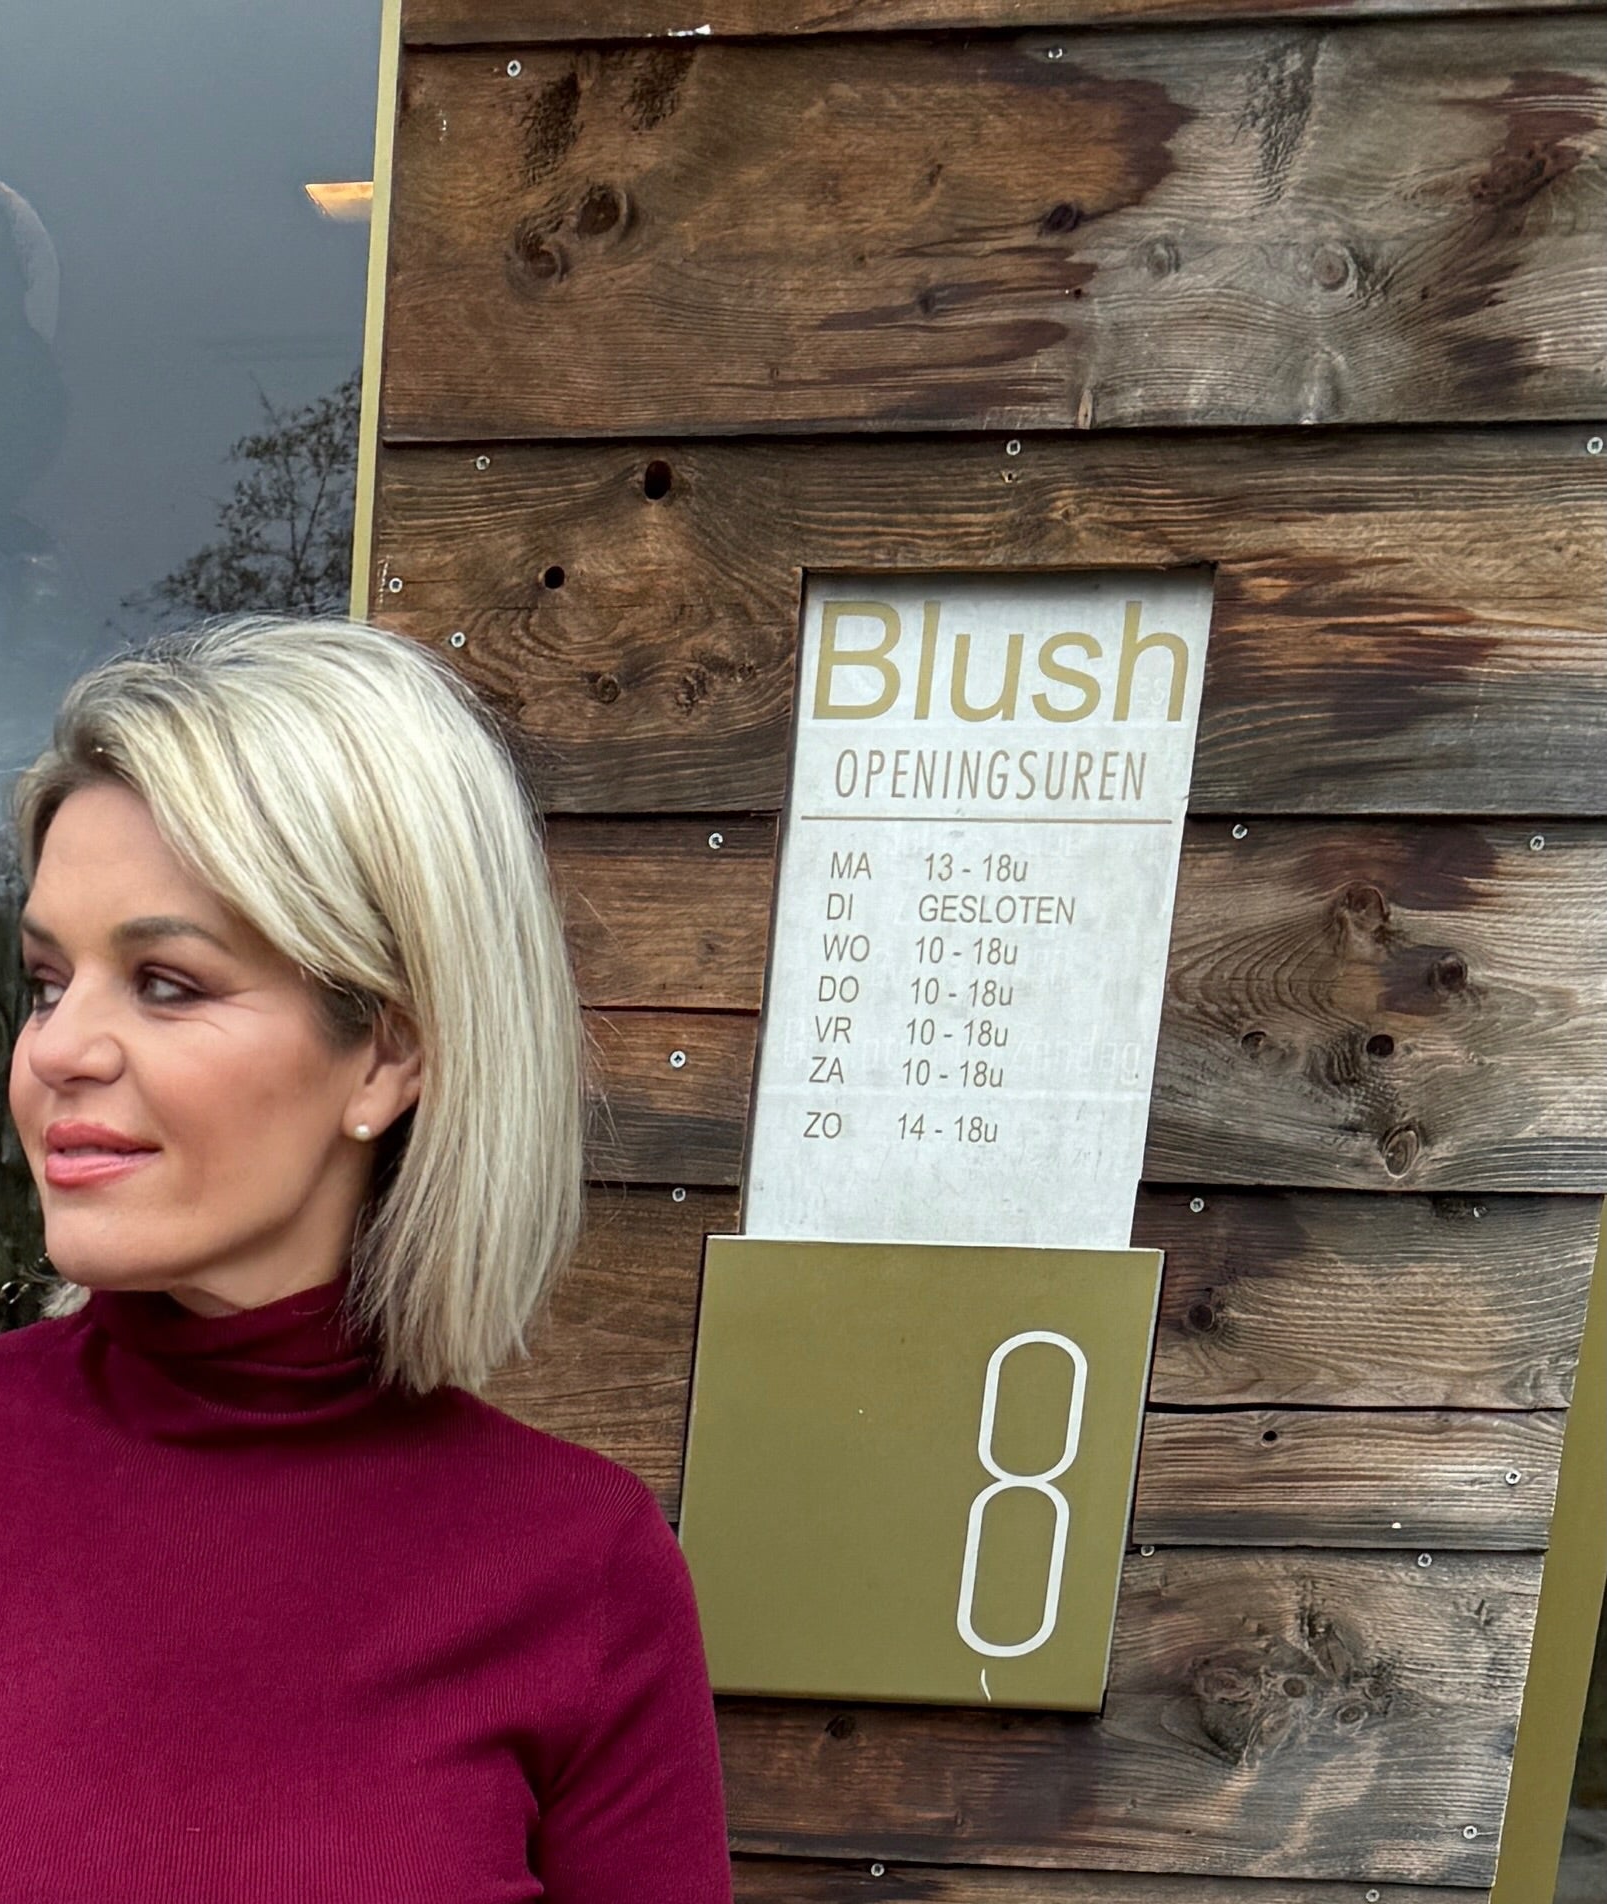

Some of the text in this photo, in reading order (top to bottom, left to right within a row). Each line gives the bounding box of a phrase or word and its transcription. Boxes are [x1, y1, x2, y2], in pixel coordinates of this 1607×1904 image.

[814, 600, 1188, 722] Blush
[835, 748, 1147, 801] OPENINGSUREN
[830, 851, 872, 880] MA
[924, 852, 954, 882] 13
[983, 853, 1029, 883] 18u
[826, 892, 1076, 925] DI GESLOTEN
[823, 933, 871, 963] WO
[915, 935, 944, 964] 10
[973, 937, 1018, 966] 18u
[818, 975, 860, 1004] DO
[911, 977, 940, 1006] 10
[969, 979, 1014, 1008] 18u
[815, 1015, 852, 1044] VR
[906, 1017, 935, 1046] 10
[963, 1019, 1009, 1048] 18u
[808, 1055, 845, 1085] ZA
[902, 1058, 931, 1087] 10
[959, 1060, 1004, 1088] 18u
[803, 1111, 843, 1140] ZO
[897, 1112, 925, 1141] 14
[954, 1115, 998, 1144] 18u
[957, 1331, 1088, 1657] 8
